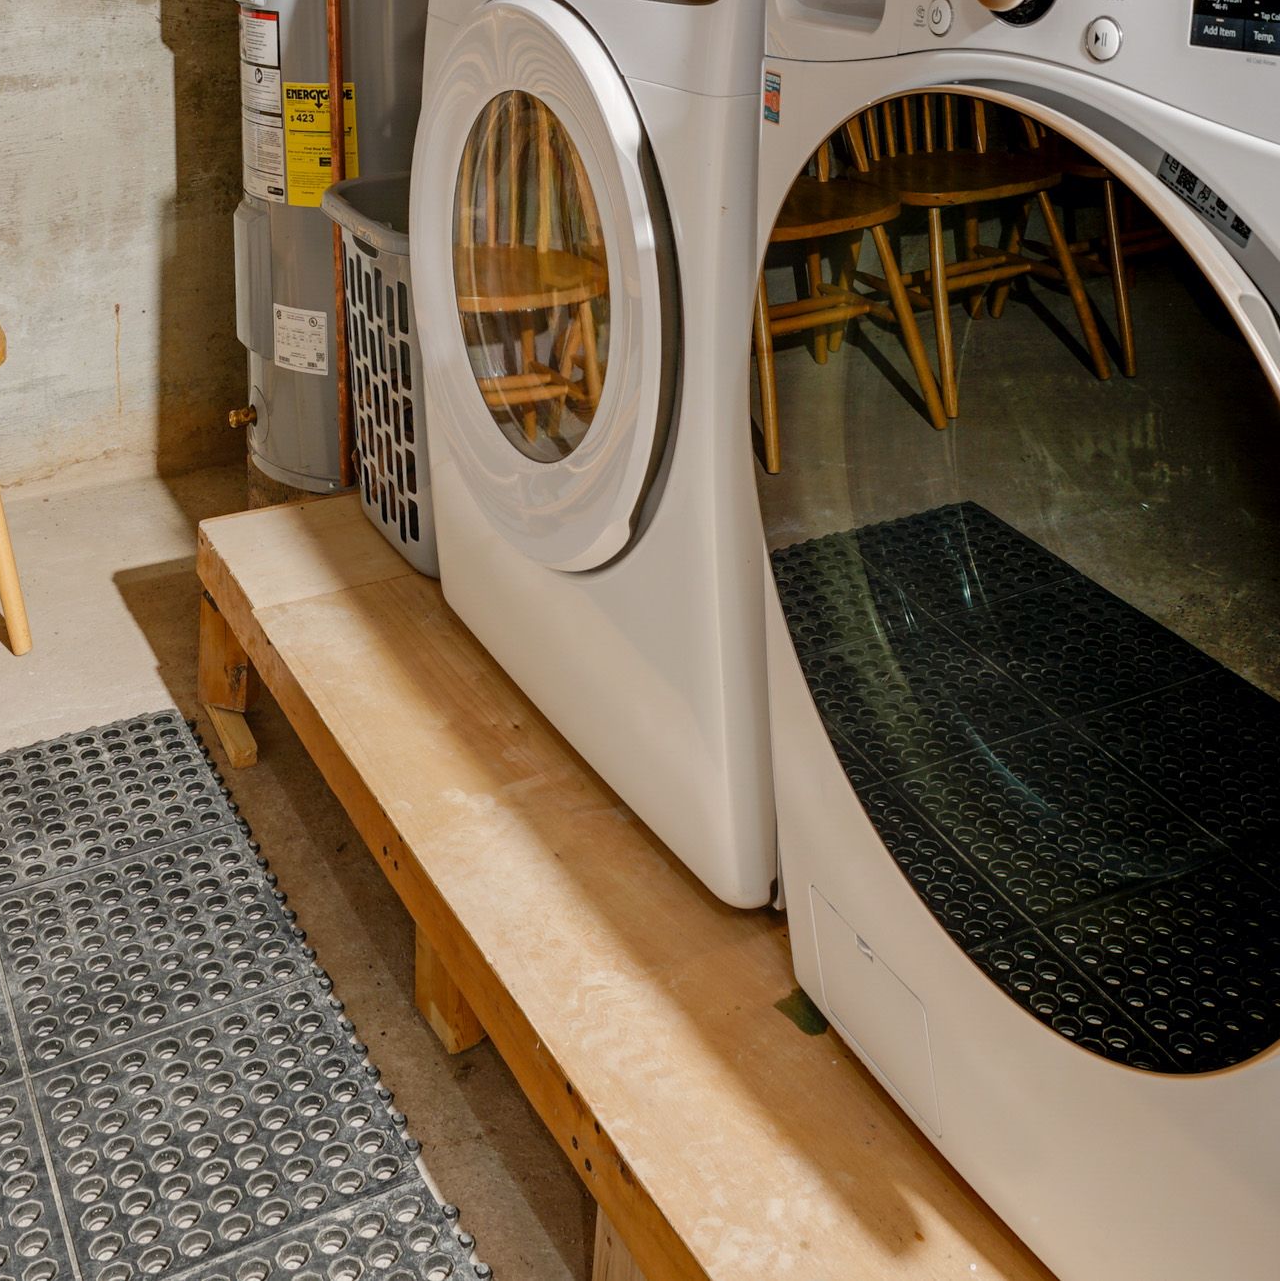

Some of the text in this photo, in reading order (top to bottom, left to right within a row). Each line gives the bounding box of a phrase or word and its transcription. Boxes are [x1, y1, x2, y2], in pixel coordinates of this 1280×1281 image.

[1203, 25, 1236, 38] Add Item
[296, 114, 314, 122] 423
